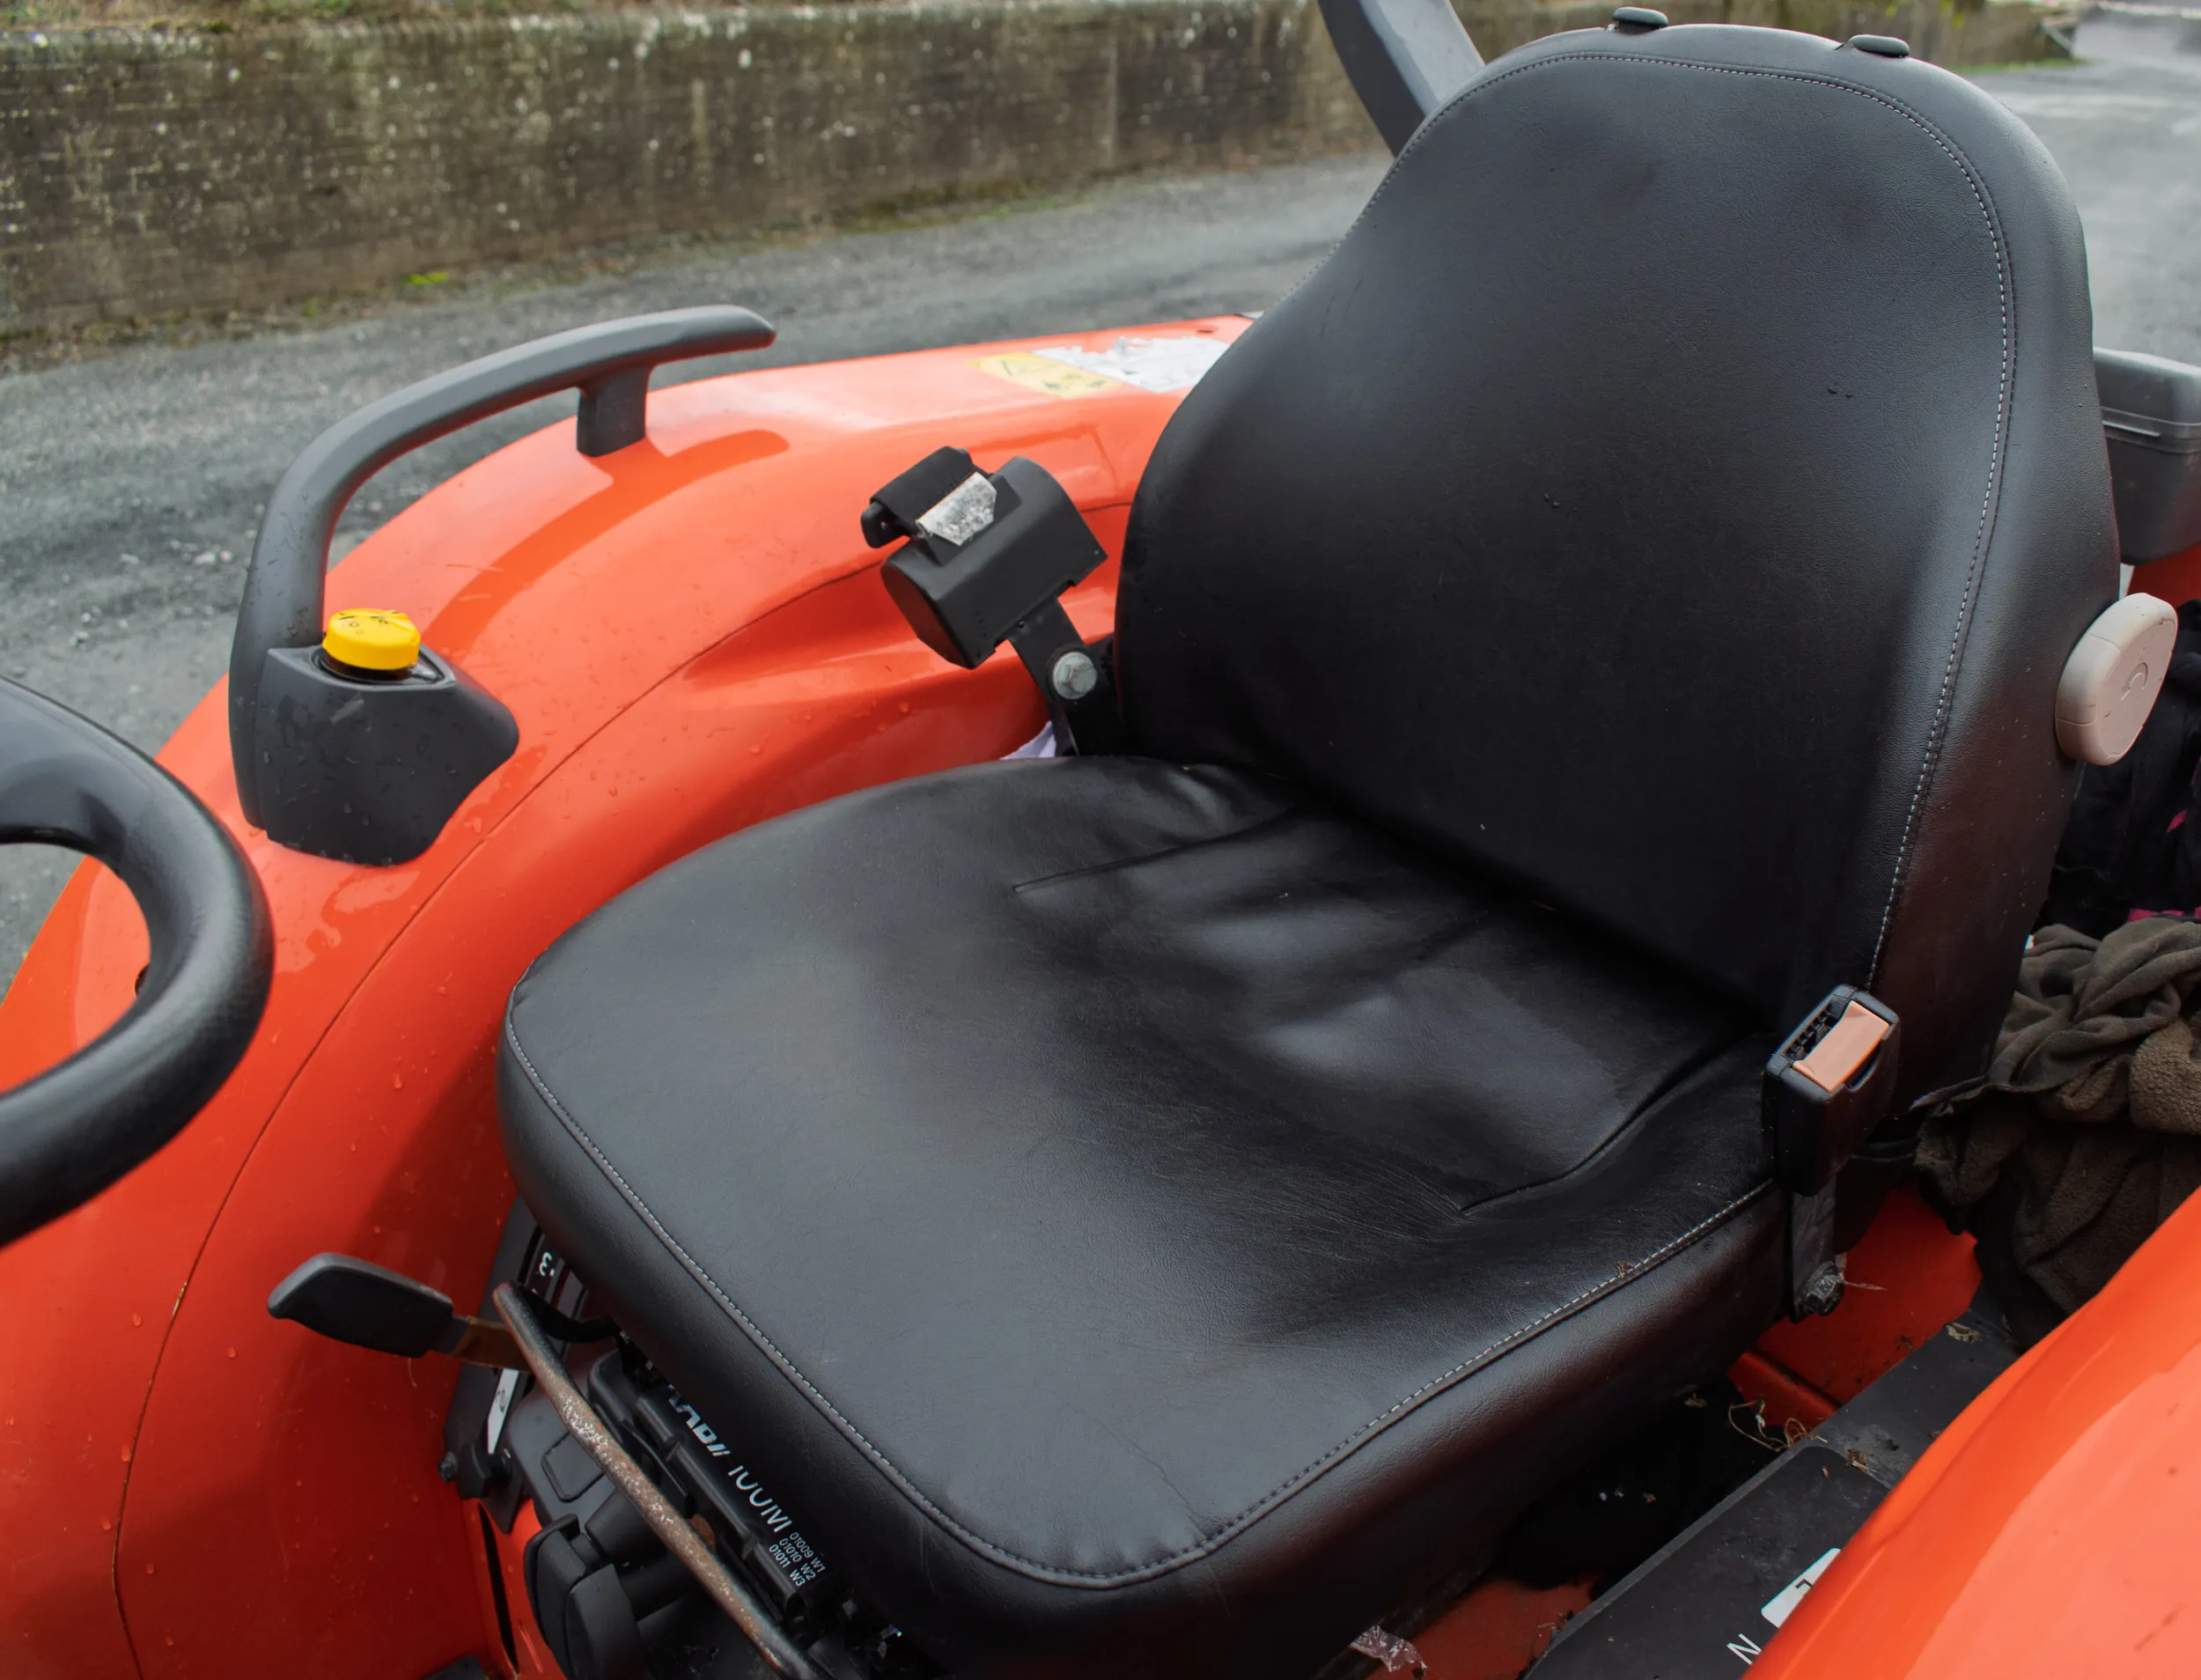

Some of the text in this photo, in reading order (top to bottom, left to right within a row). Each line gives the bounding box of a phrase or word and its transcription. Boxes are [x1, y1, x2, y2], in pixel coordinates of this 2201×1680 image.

[769, 1544, 806, 1587] 01011 W3
[779, 1537, 816, 1581] 01010 W2
[790, 1531, 826, 1573] 01009 W1
[1726, 1632, 1763, 1666] N
